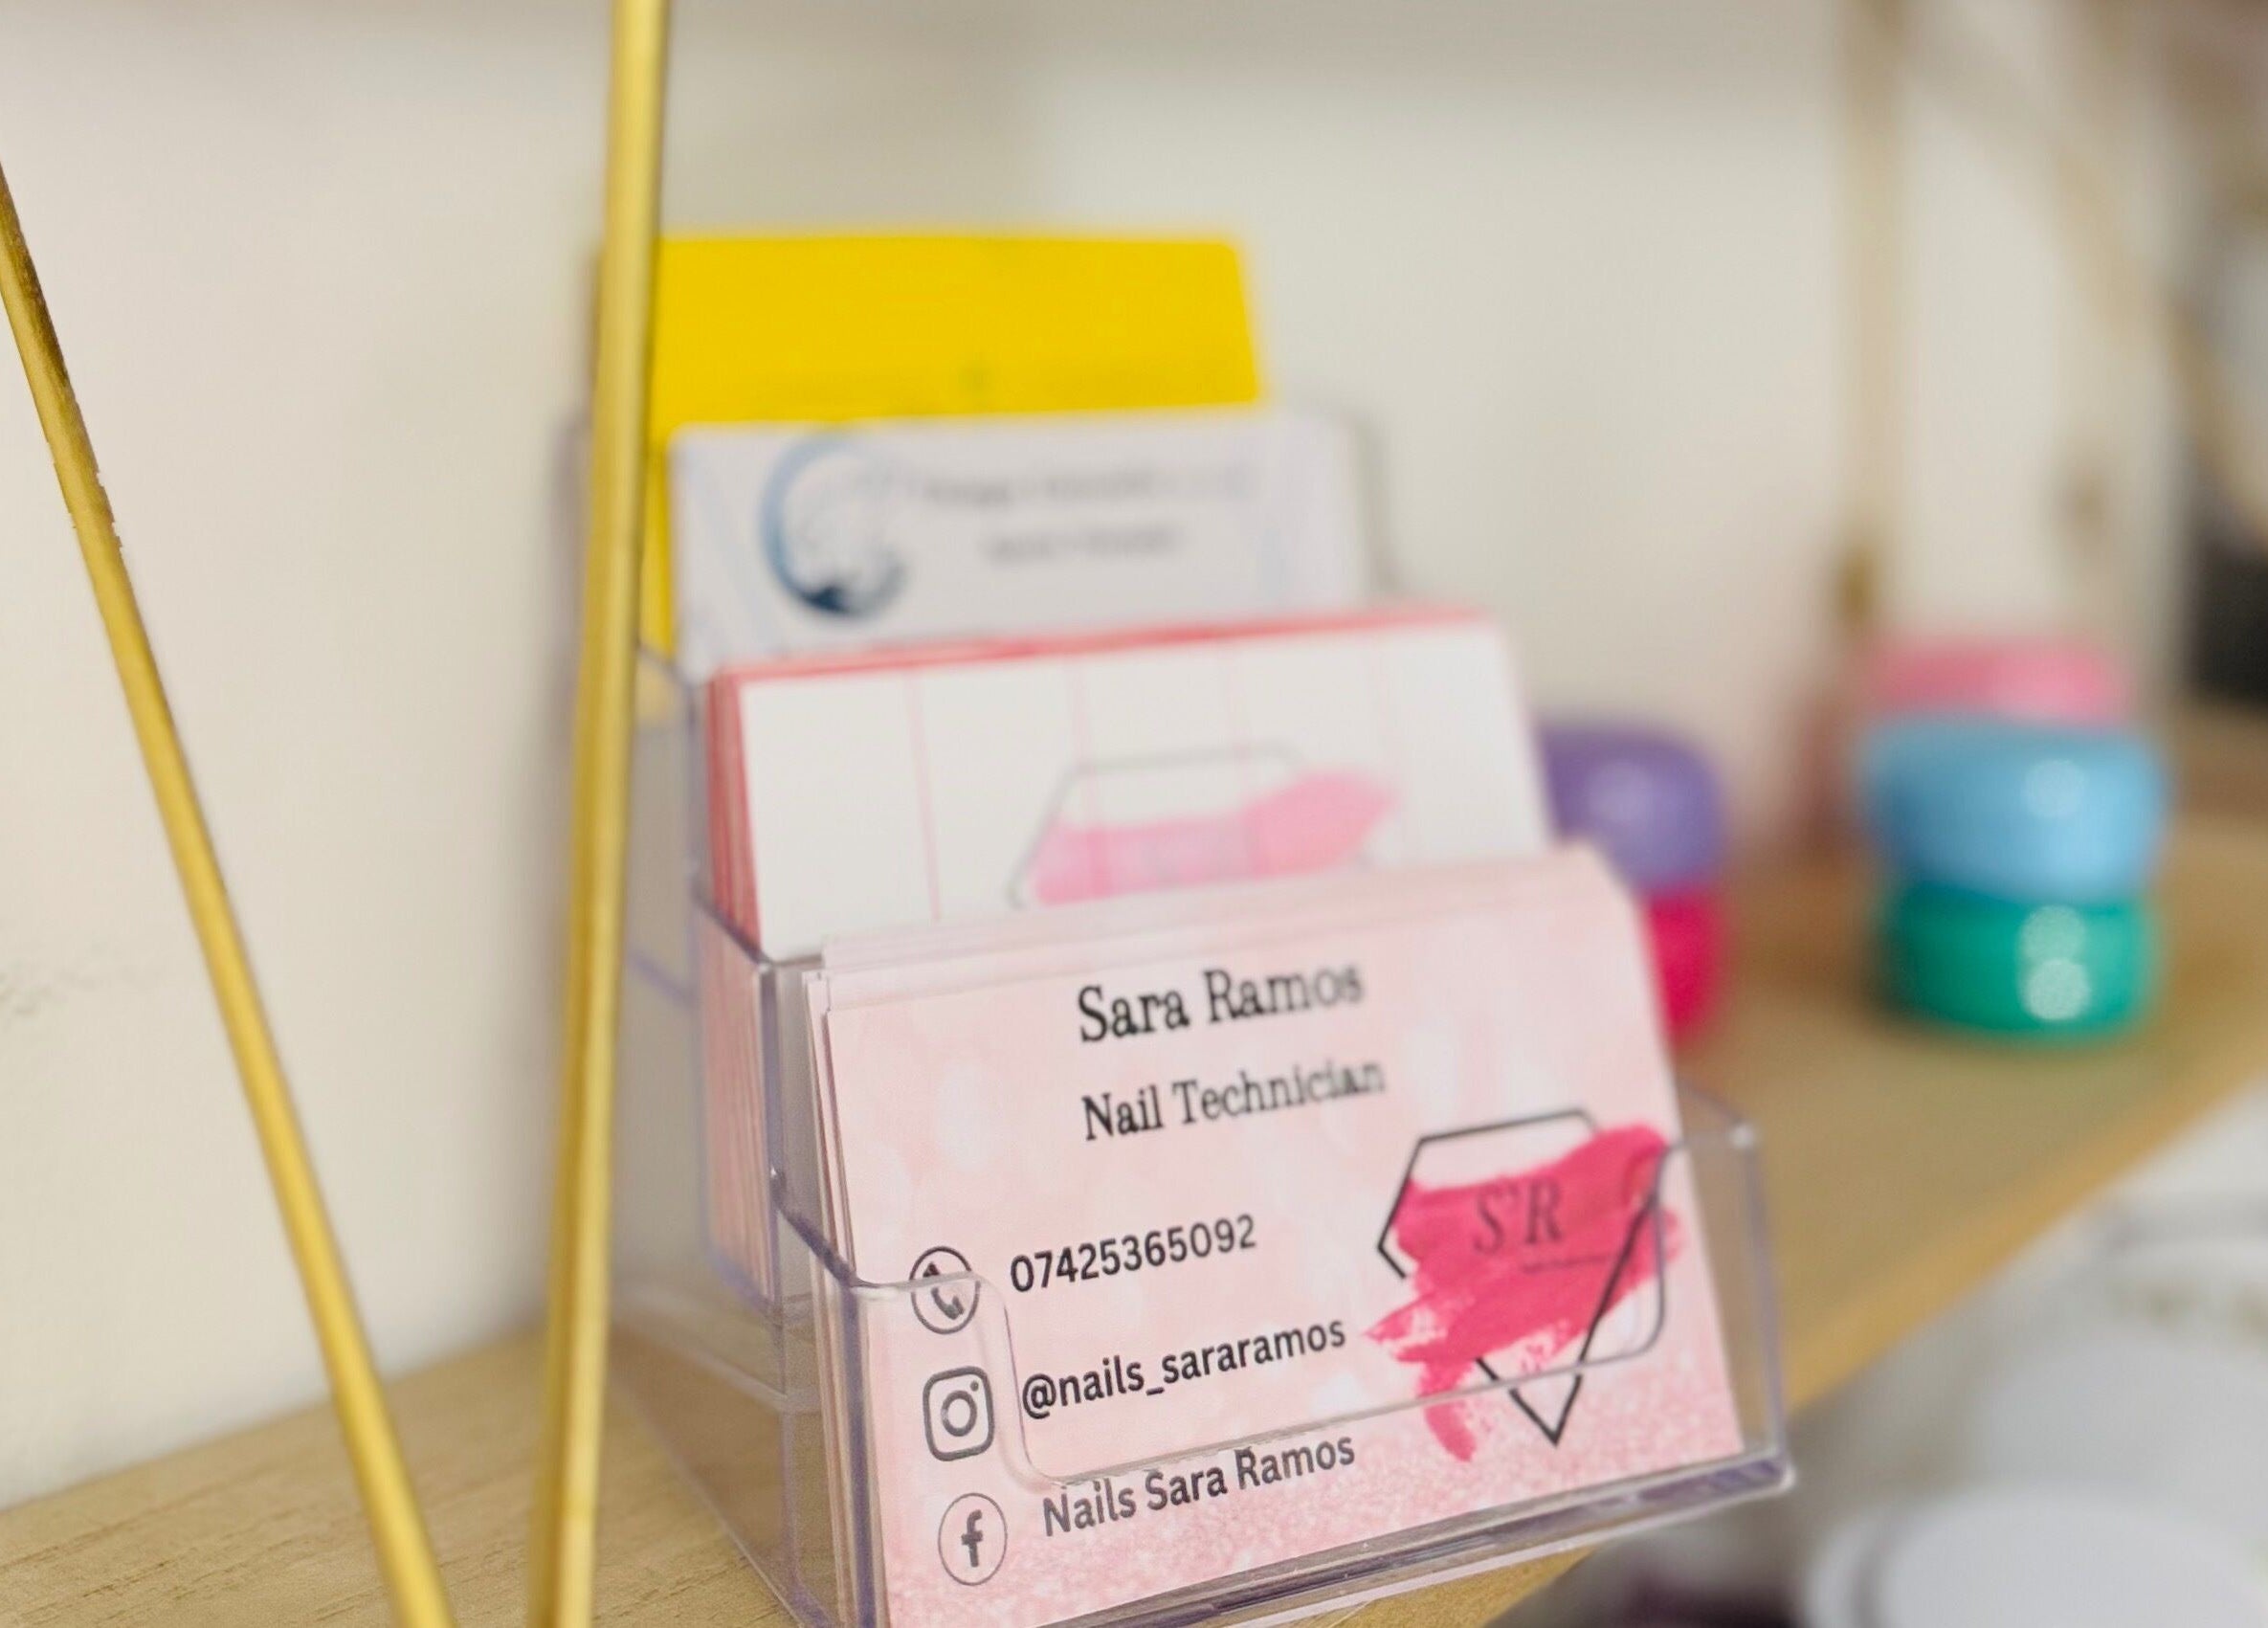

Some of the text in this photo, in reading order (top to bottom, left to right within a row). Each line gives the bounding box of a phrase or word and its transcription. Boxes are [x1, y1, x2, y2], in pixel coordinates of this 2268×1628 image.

[1077, 964, 1366, 1043] Sara Ramos
[1081, 1059, 1386, 1141] Nail Technician
[1009, 1213, 1257, 1293] 07425365092
[1021, 1319, 1347, 1421] @nails_sararamos
[1041, 1435, 1356, 1537] Nails Sara Ramos
